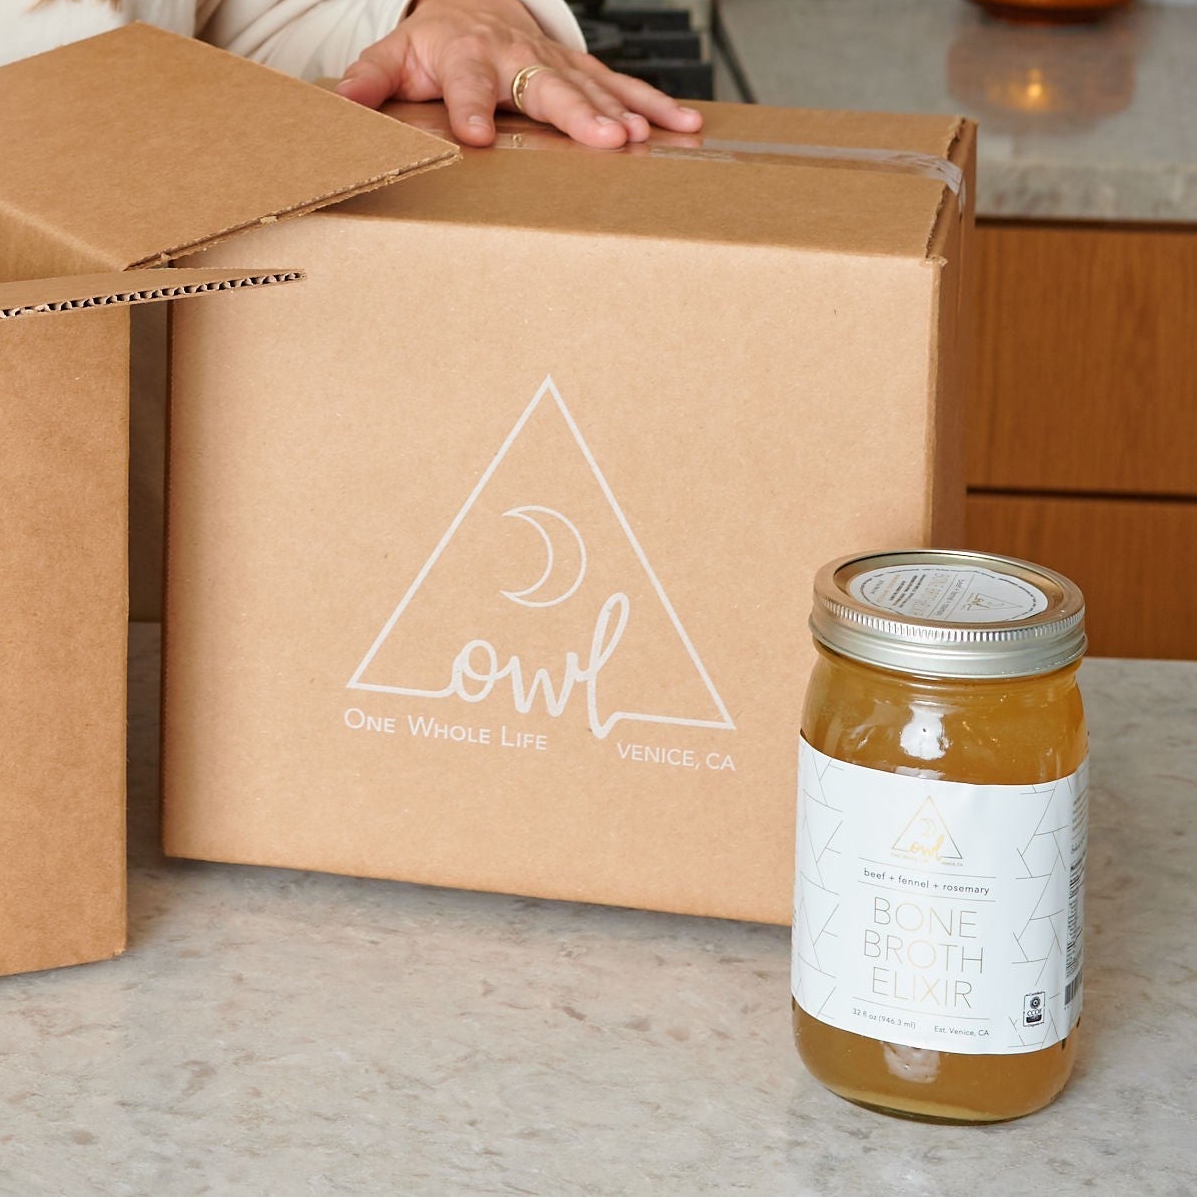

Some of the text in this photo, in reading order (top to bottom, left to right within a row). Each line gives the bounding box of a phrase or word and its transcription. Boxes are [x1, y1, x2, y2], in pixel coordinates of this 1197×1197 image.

[452, 592, 630, 739] owl
[617, 743, 736, 771] VENICE, CA
[864, 868, 886, 880] beef
[898, 875, 929, 888] fennel
[943, 884, 990, 895] rosemary
[874, 896, 977, 938] BONE
[864, 929, 983, 974] BROTH
[872, 966, 972, 1009] ELIXIR
[852, 1008, 862, 1016] 32
[904, 1021, 916, 1029] ml)
[934, 1025, 990, 1037] Est. Venice, CA
